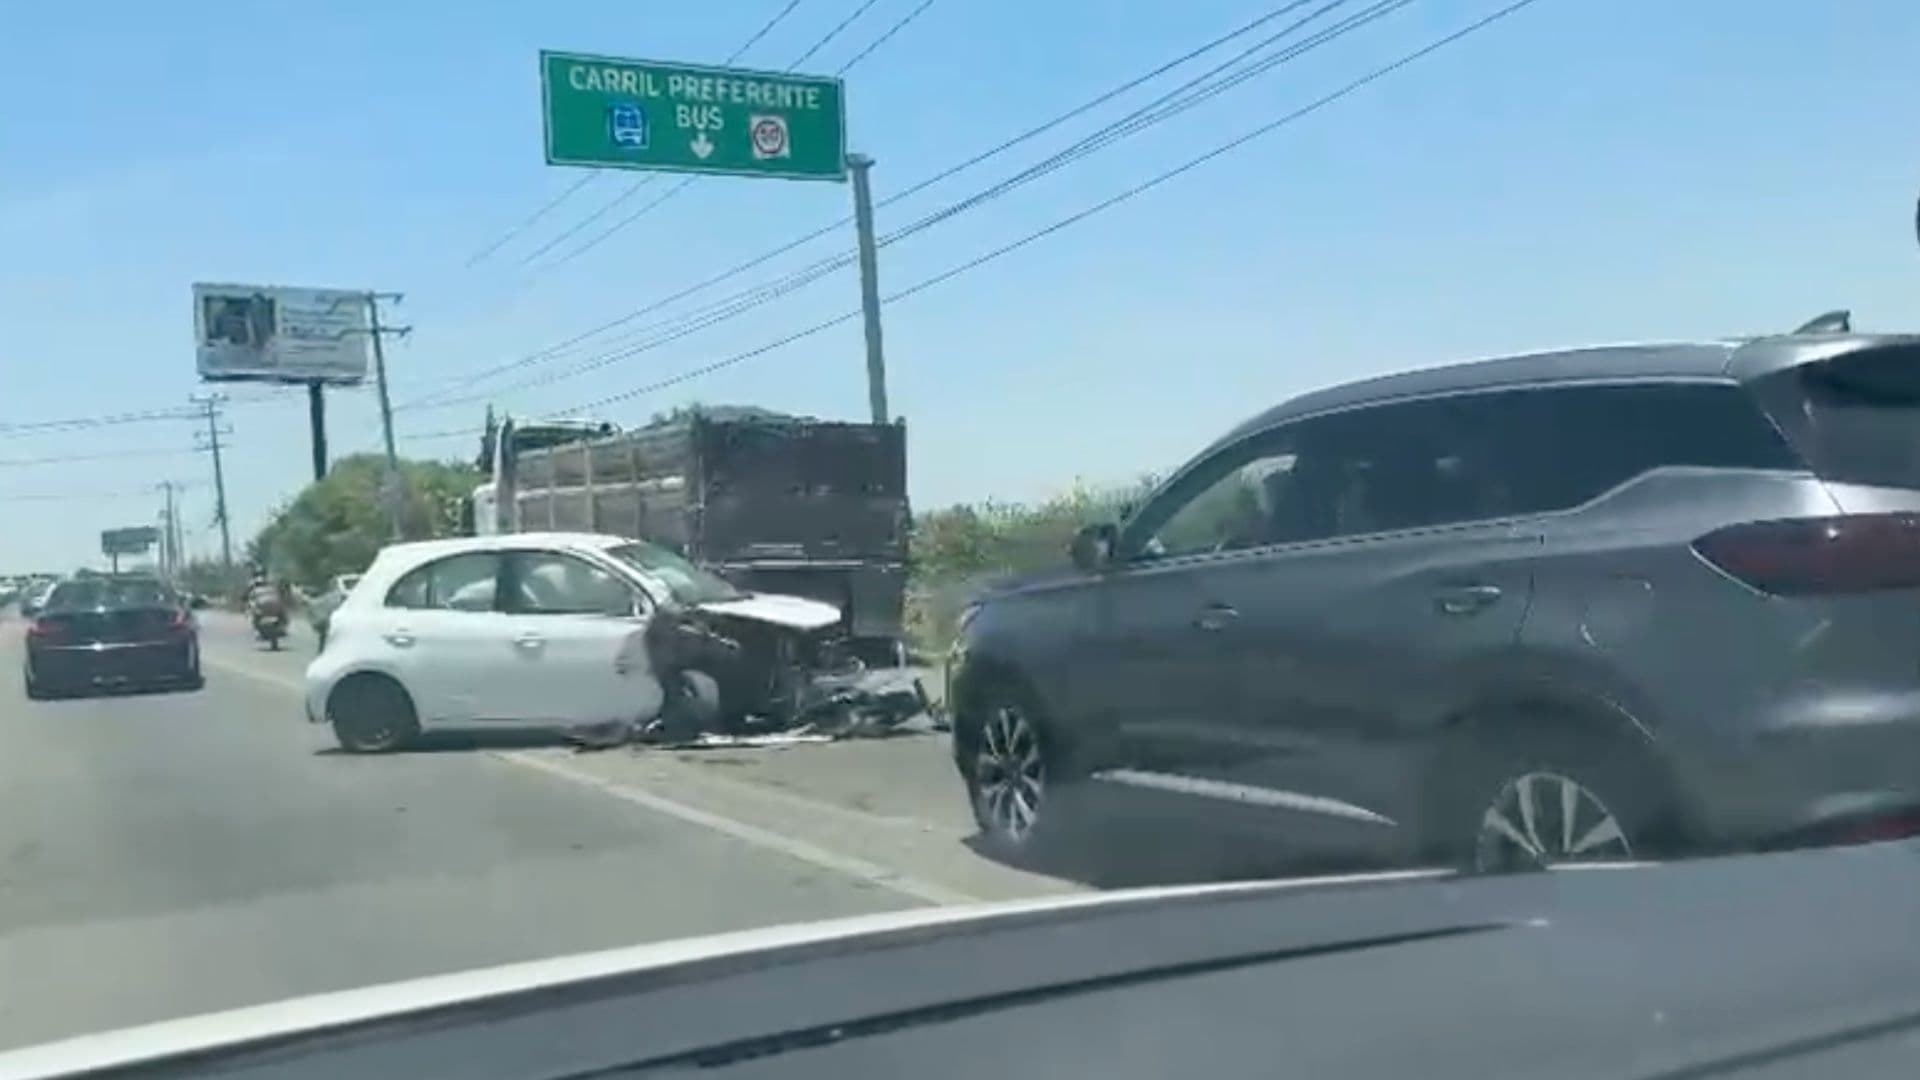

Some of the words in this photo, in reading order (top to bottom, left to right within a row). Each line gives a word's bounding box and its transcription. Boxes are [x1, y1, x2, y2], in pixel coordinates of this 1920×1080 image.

[569, 66, 660, 96] CARRIL
[668, 75, 820, 109] PREFERENTE
[676, 104, 724, 131] BUS
